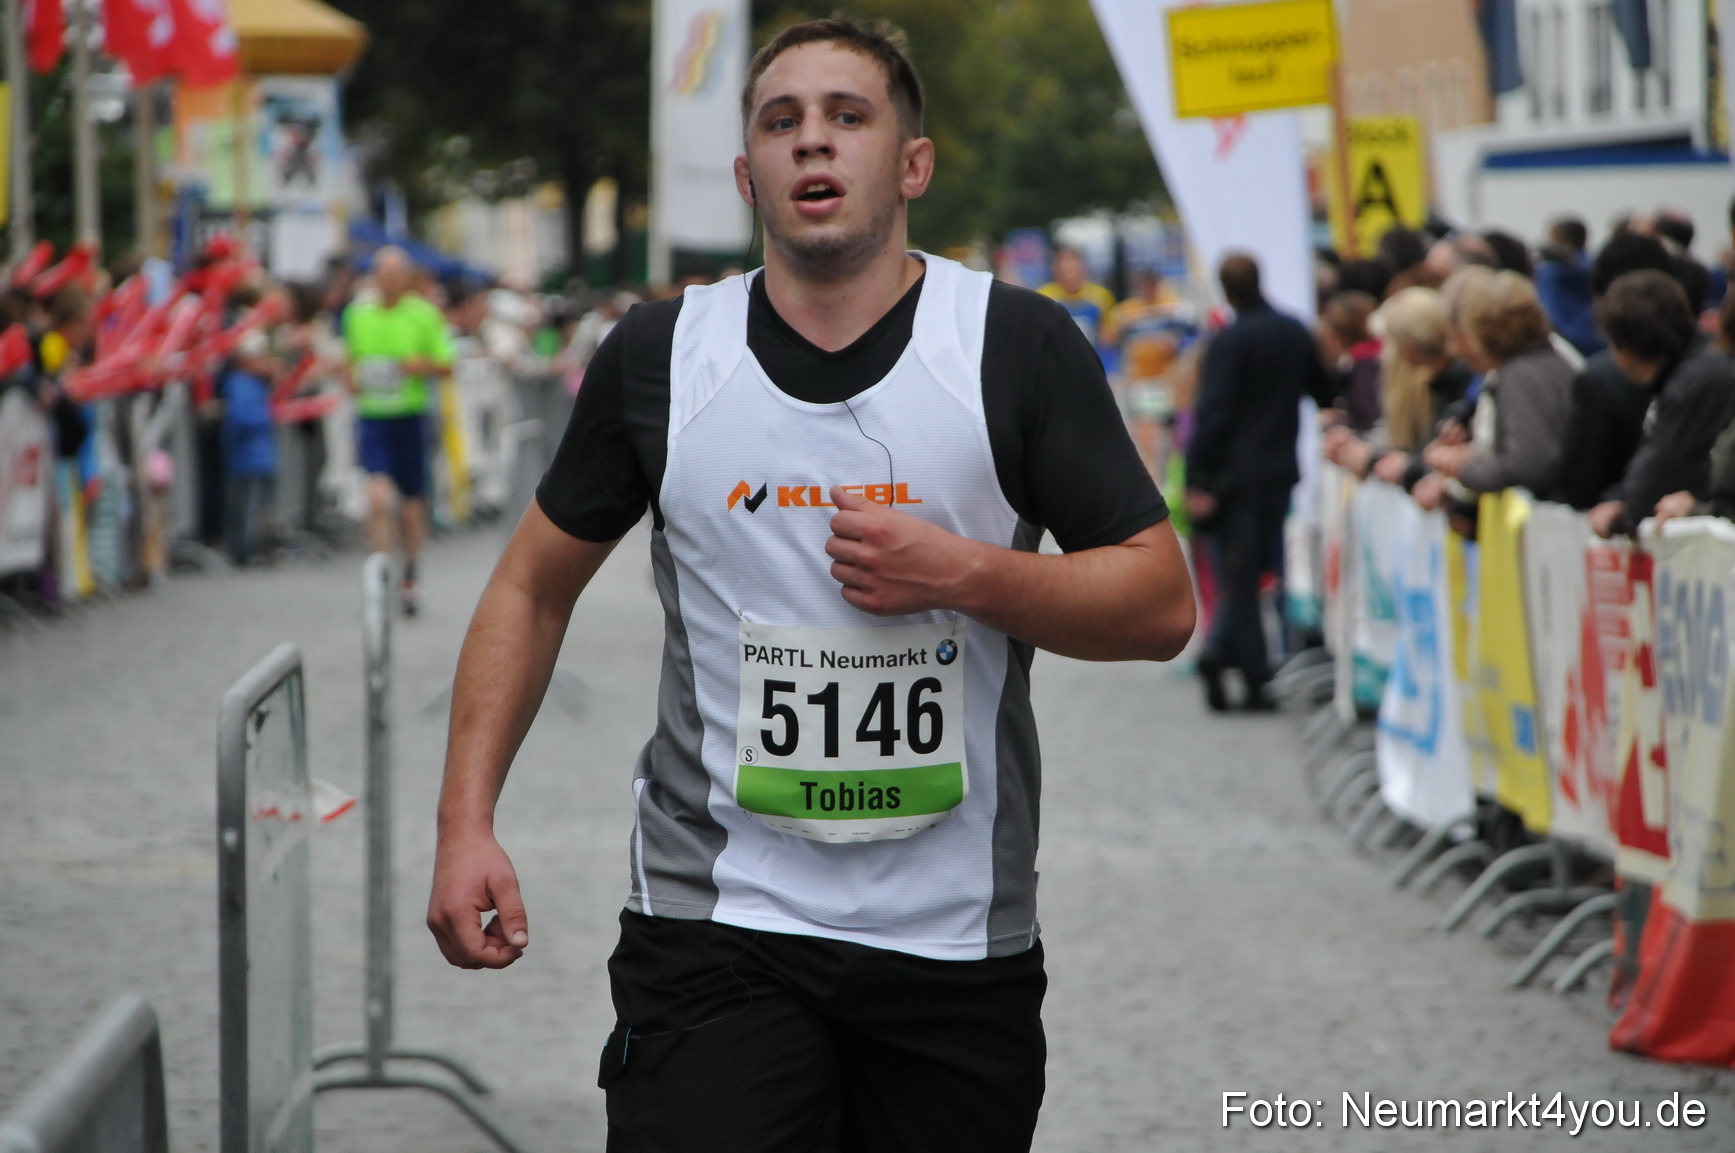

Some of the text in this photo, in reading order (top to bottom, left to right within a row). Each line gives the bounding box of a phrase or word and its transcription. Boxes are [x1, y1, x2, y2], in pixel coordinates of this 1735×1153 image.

[1354, 157, 1401, 220] A
[744, 643, 928, 670] PARTL Neumarkt
[760, 676, 944, 758] 5146
[744, 748, 755, 763] S
[800, 780, 901, 812] Tobias
